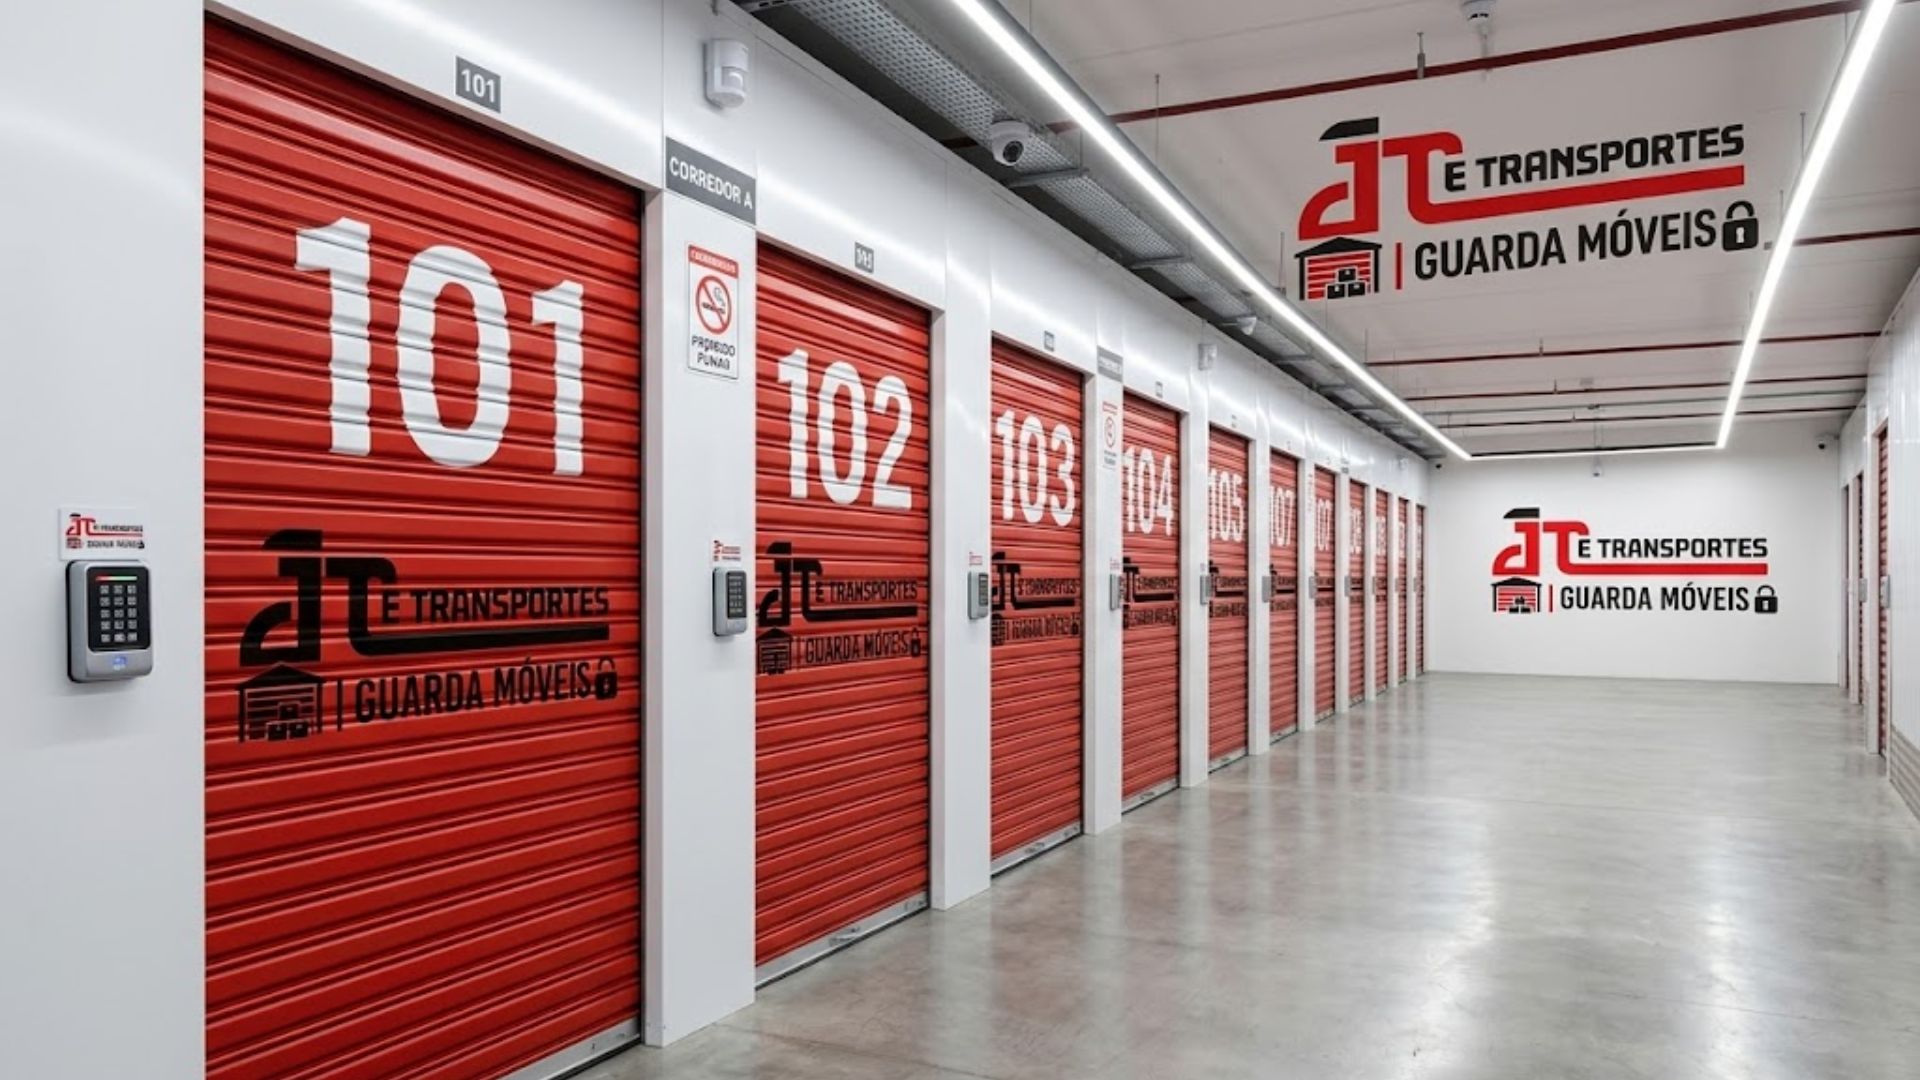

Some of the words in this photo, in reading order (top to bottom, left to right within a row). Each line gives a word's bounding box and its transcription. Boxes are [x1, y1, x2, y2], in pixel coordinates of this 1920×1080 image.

[460, 68, 496, 104] 101
[669, 156, 742, 203] CORREDOR
[744, 193, 753, 210] A
[1444, 161, 1466, 193] E
[1476, 124, 1744, 188] TRANSPORTES
[1415, 227, 1566, 281] GUARDA
[1578, 208, 1716, 262] MÓVEIS
[294, 217, 583, 476] 101
[777, 348, 913, 510] 102
[996, 409, 1076, 527] 103
[1122, 446, 1174, 537] 104
[1209, 468, 1244, 542] 105
[1578, 539, 1591, 559] E
[1598, 538, 1768, 559] TRANSPORTES
[382, 589, 400, 623] E
[410, 586, 608, 623] TRANSPORTES
[830, 580, 918, 603] TRANSPORTES
[1561, 585, 1653, 610] GUARDA
[1661, 582, 1749, 611] MÓVEIS
[356, 671, 484, 722] GUARDA
[494, 657, 592, 707] MÓVEIS
